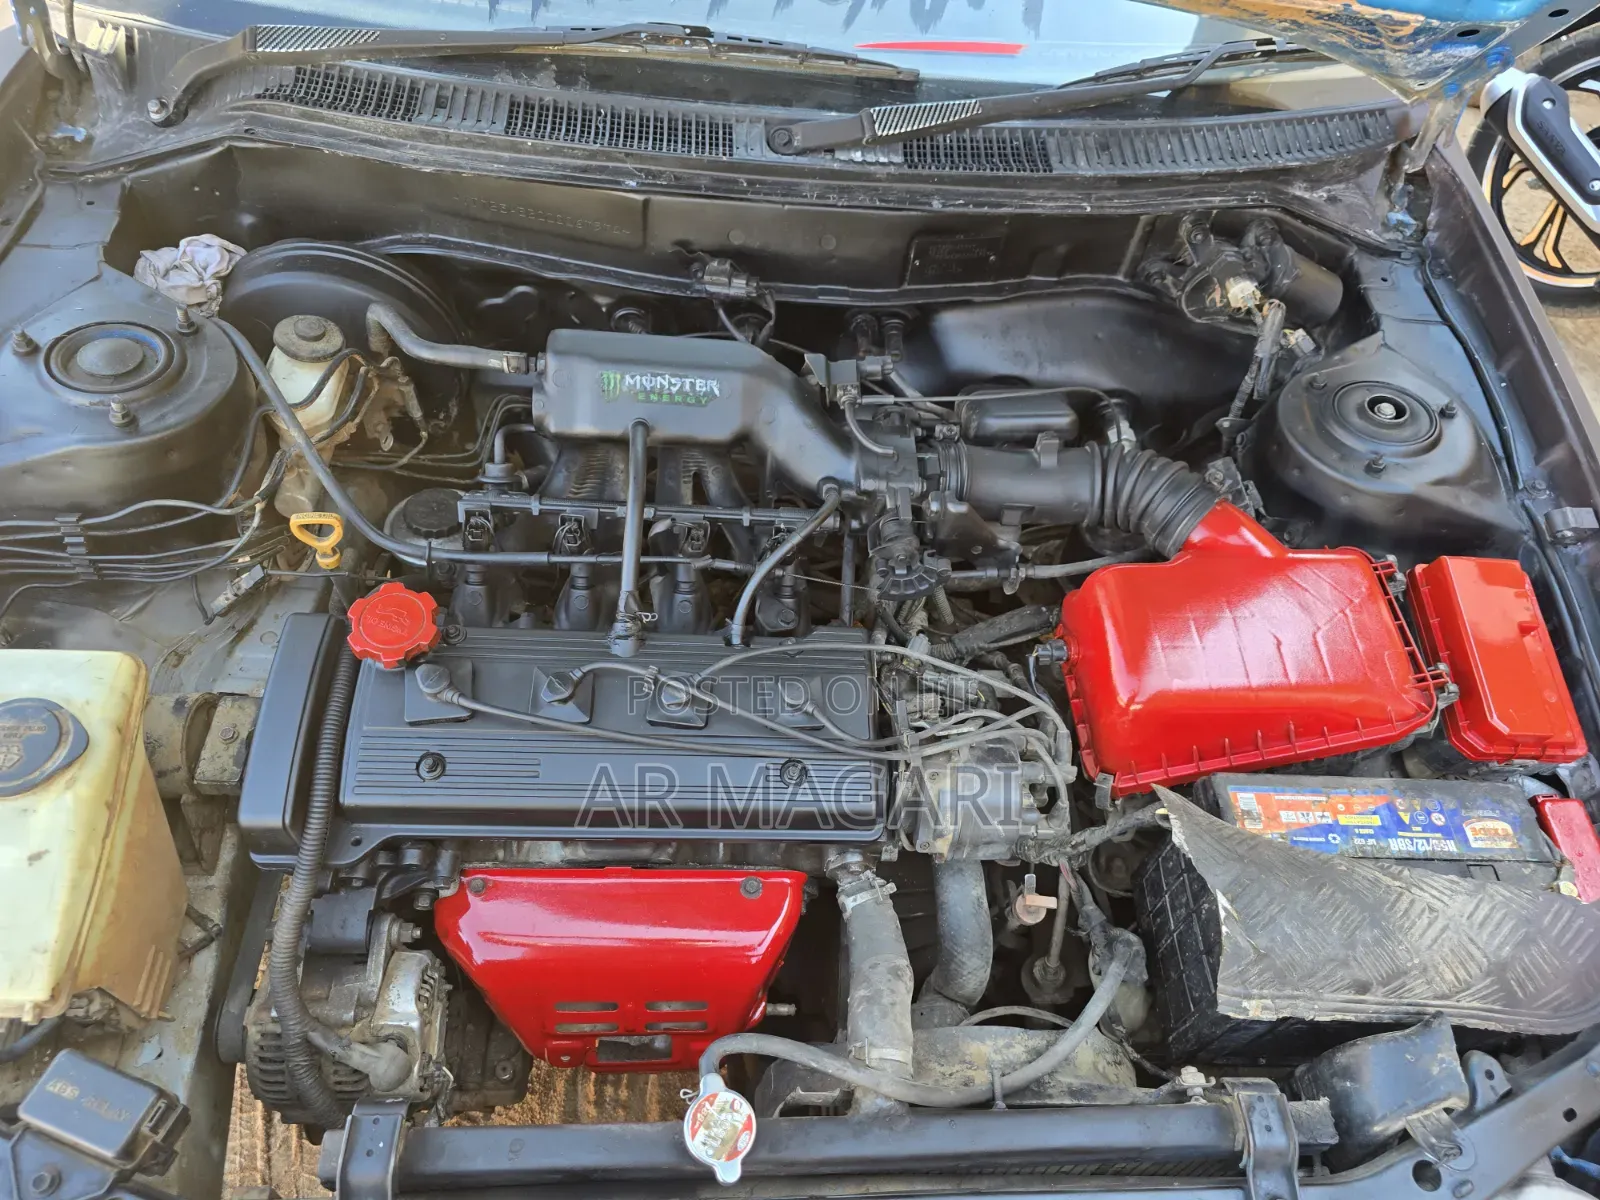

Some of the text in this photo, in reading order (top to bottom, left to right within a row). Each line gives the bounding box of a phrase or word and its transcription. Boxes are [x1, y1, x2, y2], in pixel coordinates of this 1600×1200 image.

[624, 373, 720, 397] MONSTER
[638, 392, 708, 405] ENERGY
[45, 1078, 80, 1099] ABS
